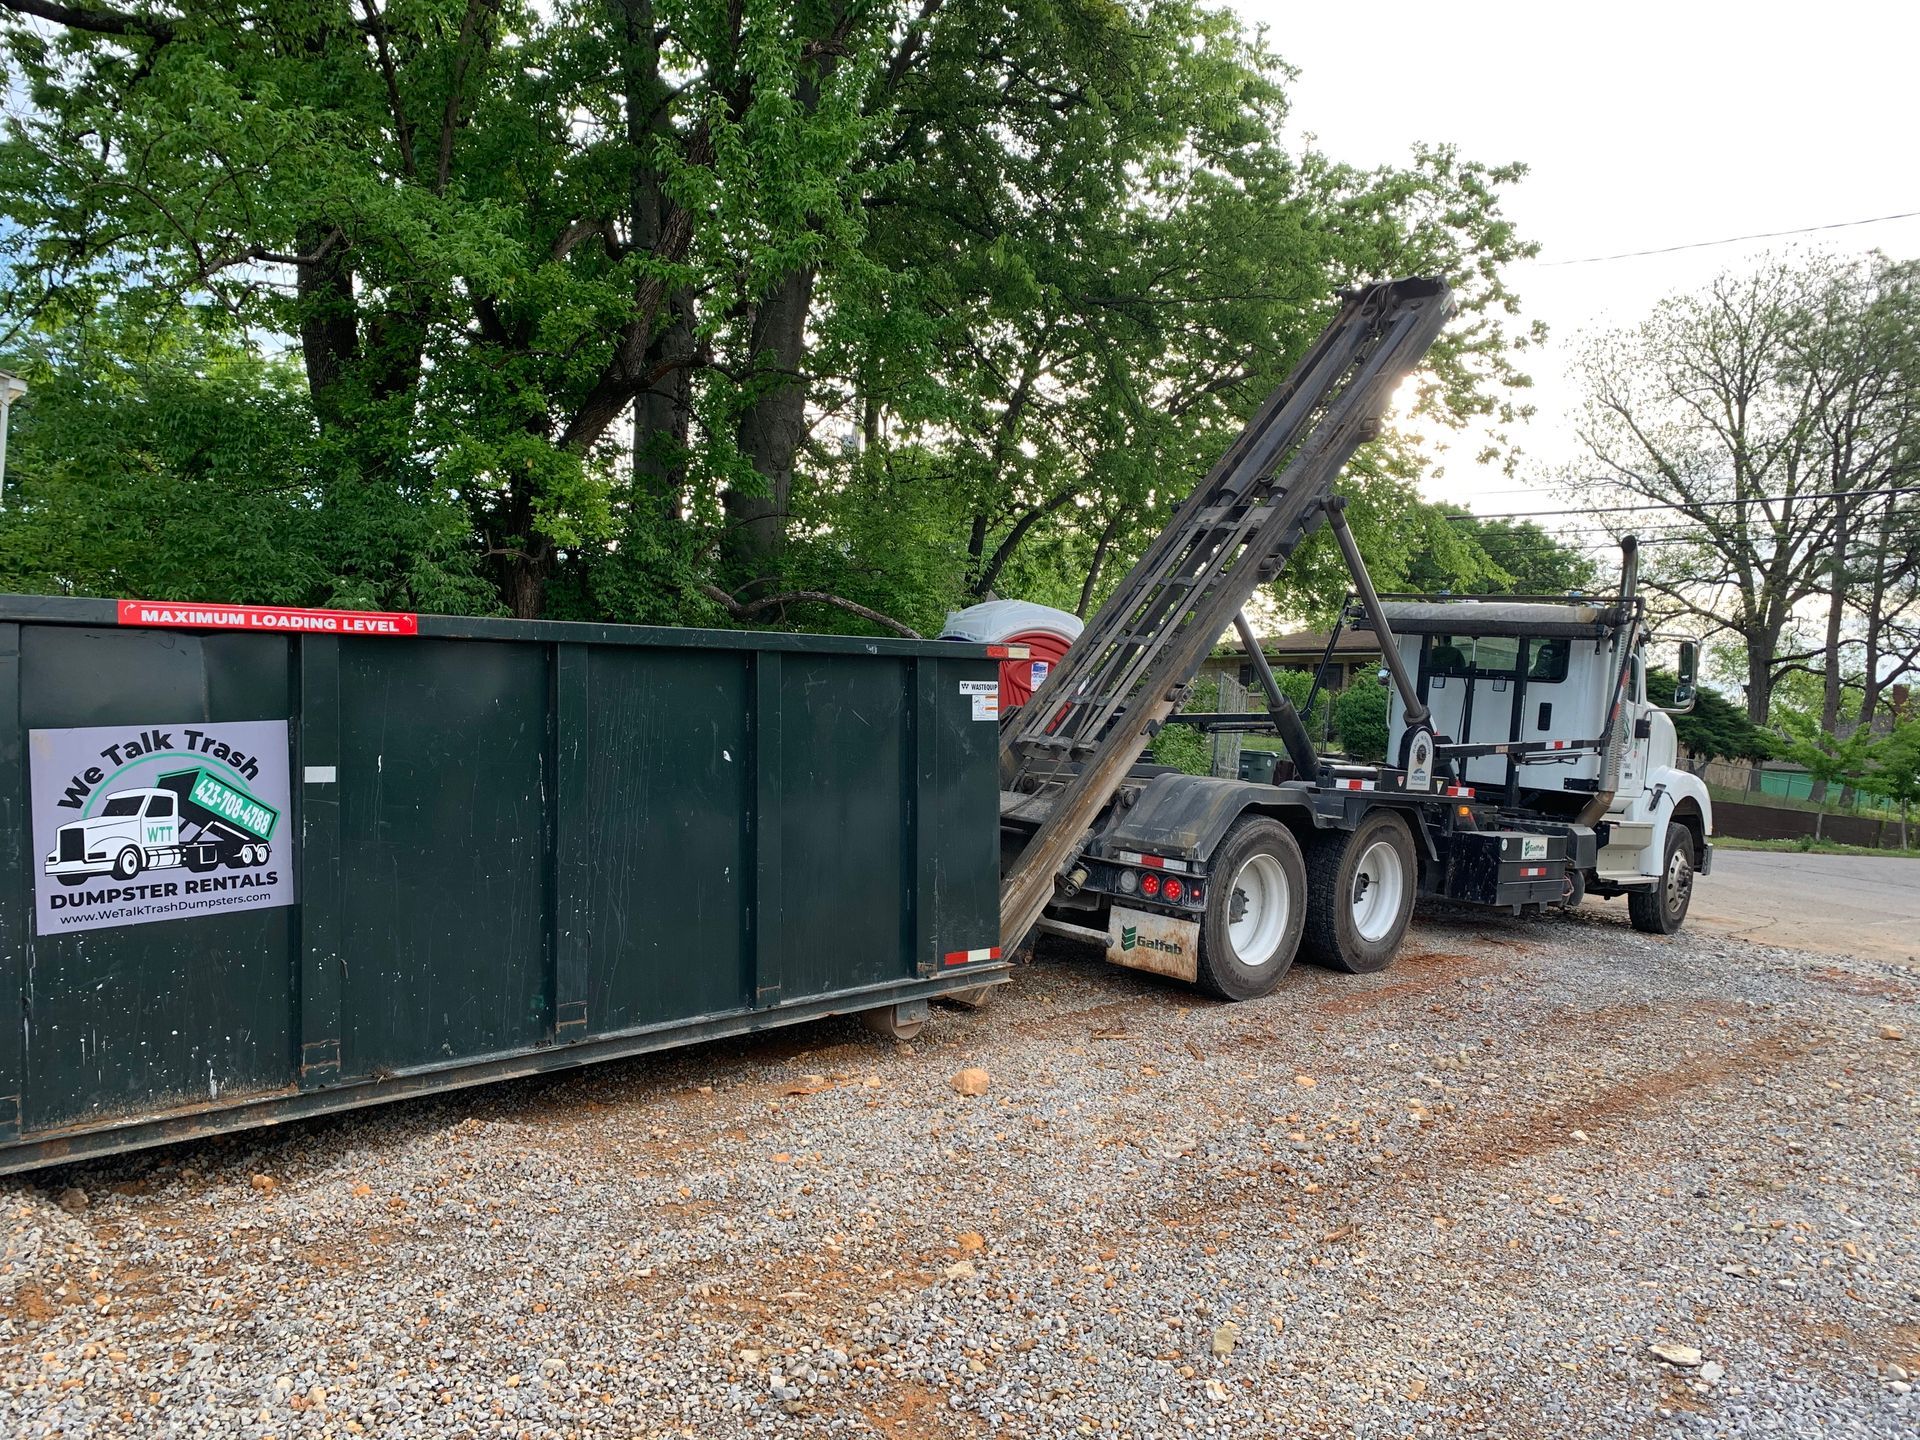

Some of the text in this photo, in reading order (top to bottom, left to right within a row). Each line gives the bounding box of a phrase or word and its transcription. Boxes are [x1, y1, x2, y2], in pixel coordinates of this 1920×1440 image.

[141, 610, 400, 632] MAXIMUM LOADING LEVEL
[971, 683, 998, 691] WASTEQUIP
[57, 730, 259, 809] We Talk Trash
[195, 779, 271, 834] 423-708-4788
[147, 826, 173, 842] WTT
[50, 871, 278, 910] DUMPSTER RENTALS
[60, 891, 271, 925] www.WeTalkTrashDumpsters.com
[1137, 935, 1183, 955] Galfab
